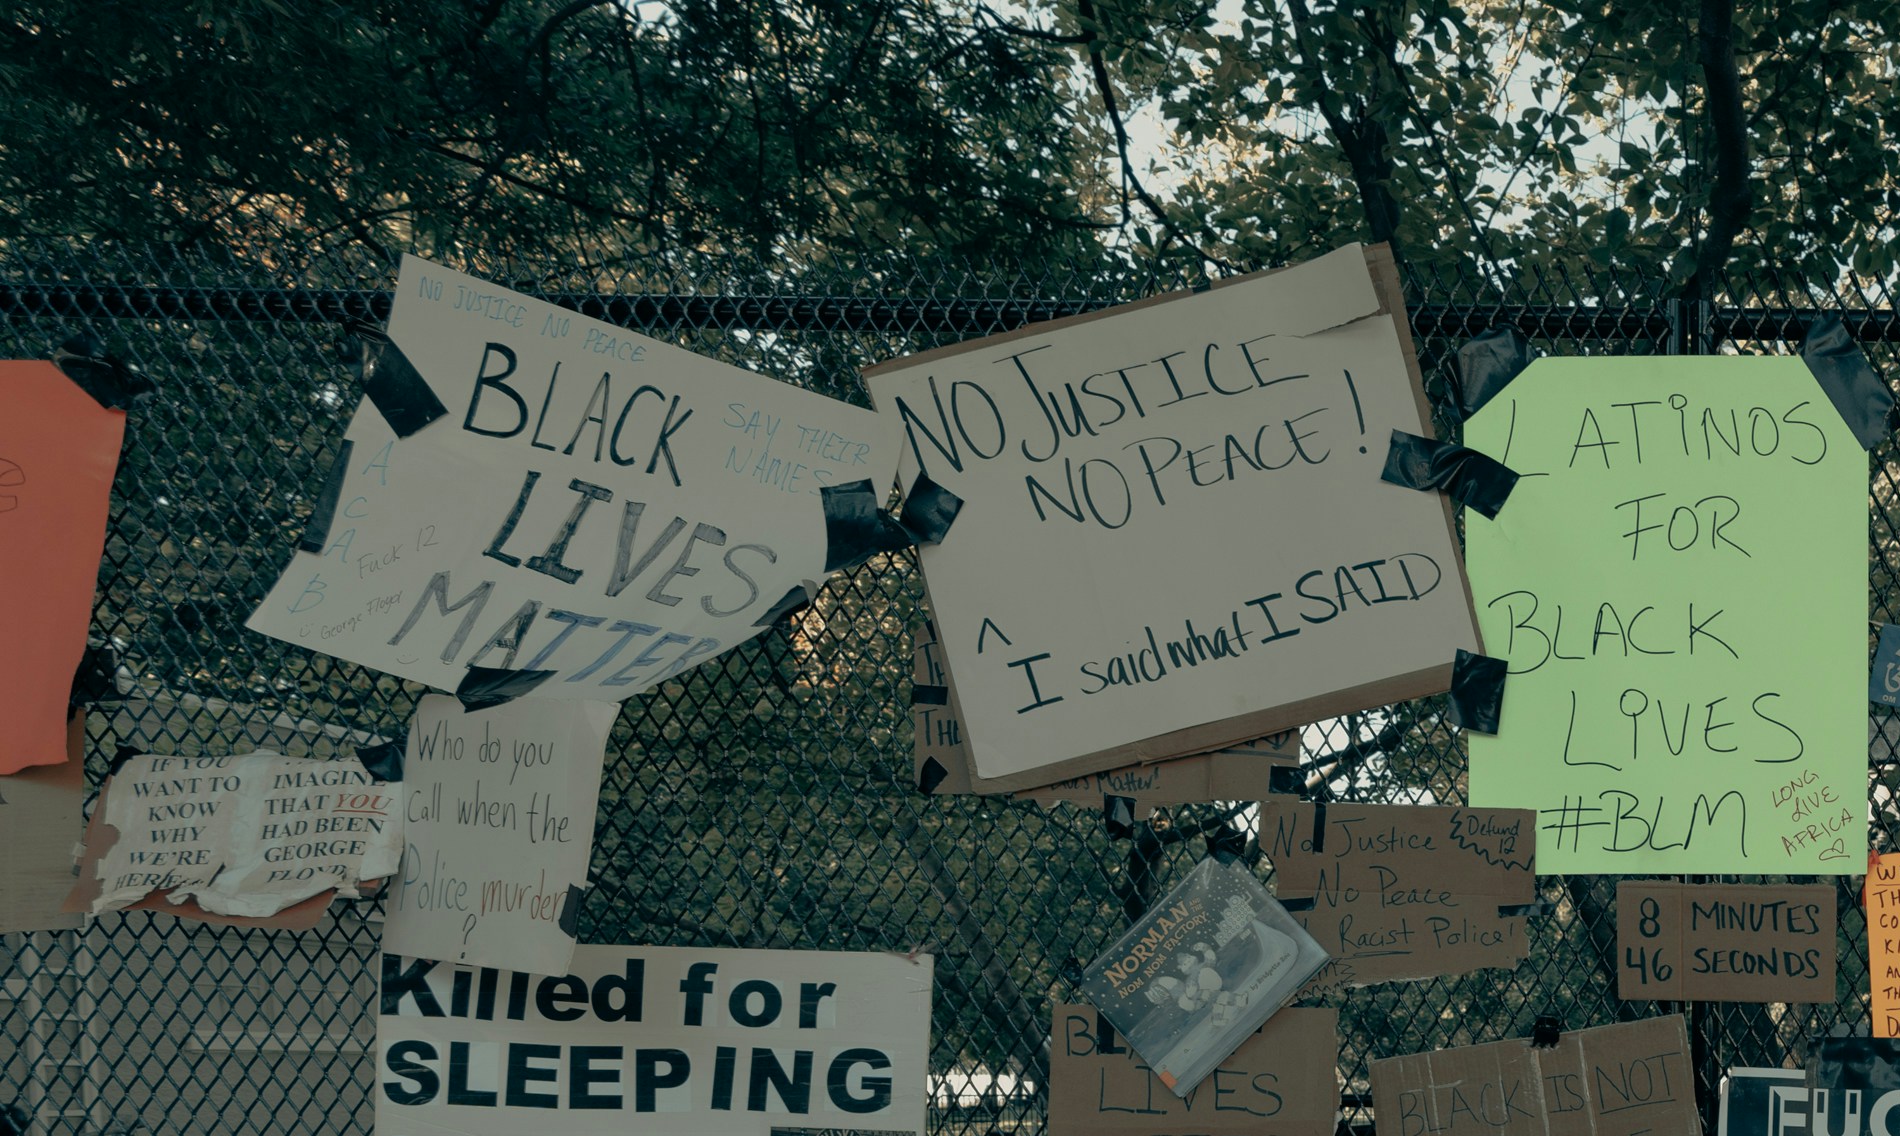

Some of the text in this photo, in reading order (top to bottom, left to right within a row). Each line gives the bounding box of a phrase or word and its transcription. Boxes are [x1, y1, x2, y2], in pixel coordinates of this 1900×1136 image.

[453, 283, 647, 364] JUSTICE PEACE
[463, 342, 693, 487] BLACK
[724, 402, 870, 467] SAY THEIR
[895, 376, 1006, 472] NO
[1024, 457, 1131, 529] NO
[482, 470, 777, 622] LIVES
[1615, 493, 1751, 560] FOR
[387, 571, 720, 688] MATTER
[1081, 553, 1442, 694] said SAID
[1488, 591, 1738, 674] BLACK
[417, 719, 553, 782] Who you
[134, 776, 200, 796] WANT
[149, 801, 221, 821] KNOW
[265, 796, 331, 816] THAT
[152, 826, 205, 843] WHY
[262, 819, 309, 839] HAD
[457, 793, 572, 844] when the
[1332, 818, 1433, 856] Justice
[1467, 814, 1519, 838] Defund
[1541, 791, 1747, 858] #BLM
[1781, 808, 1853, 857] AFRICA
[265, 839, 364, 862] GEORGE
[481, 879, 567, 921] murder
[1368, 866, 1459, 909] Peace
[1639, 897, 1820, 938] 8 MINUTES
[1105, 900, 1189, 988] NORMAN
[1164, 912, 1208, 952] FACTORY
[380, 953, 836, 1029] Killed for
[1626, 948, 1820, 983] 46 SECONDS
[383, 1040, 892, 1114] SLEEPING
[1597, 1053, 1682, 1113] NOT
